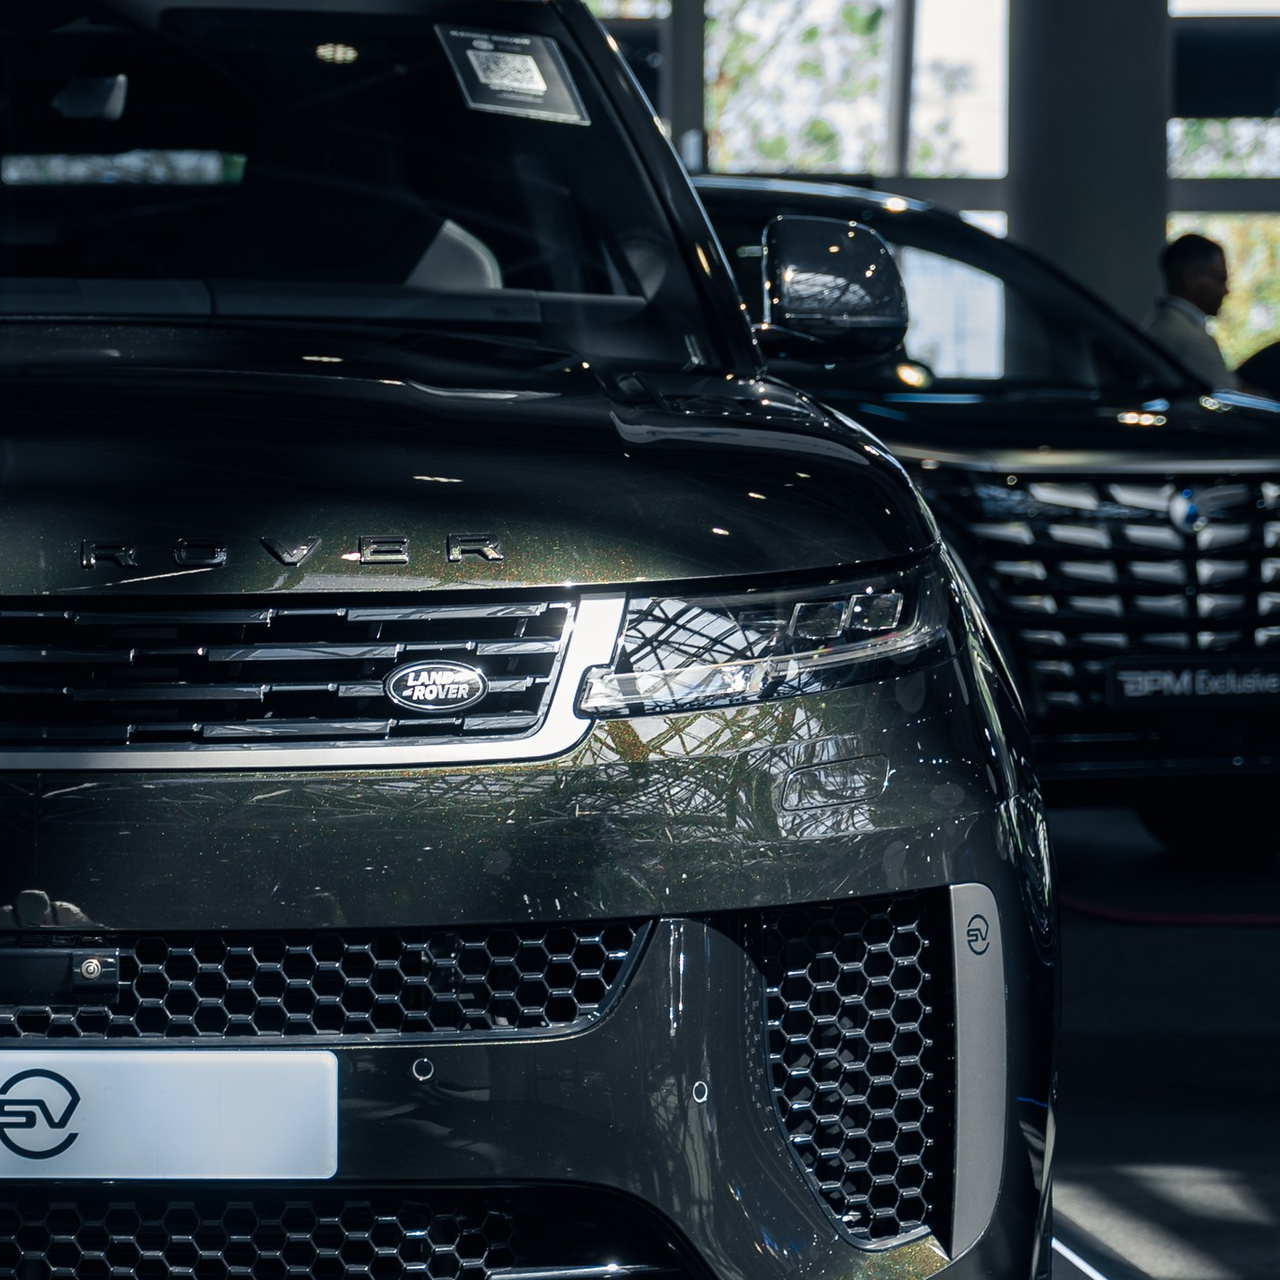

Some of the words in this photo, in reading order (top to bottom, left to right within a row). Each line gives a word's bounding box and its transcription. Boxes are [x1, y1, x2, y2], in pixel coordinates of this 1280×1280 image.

[80, 531, 505, 569] ROVER
[406, 670, 457, 687] LAND
[411, 684, 470, 701] ROVER
